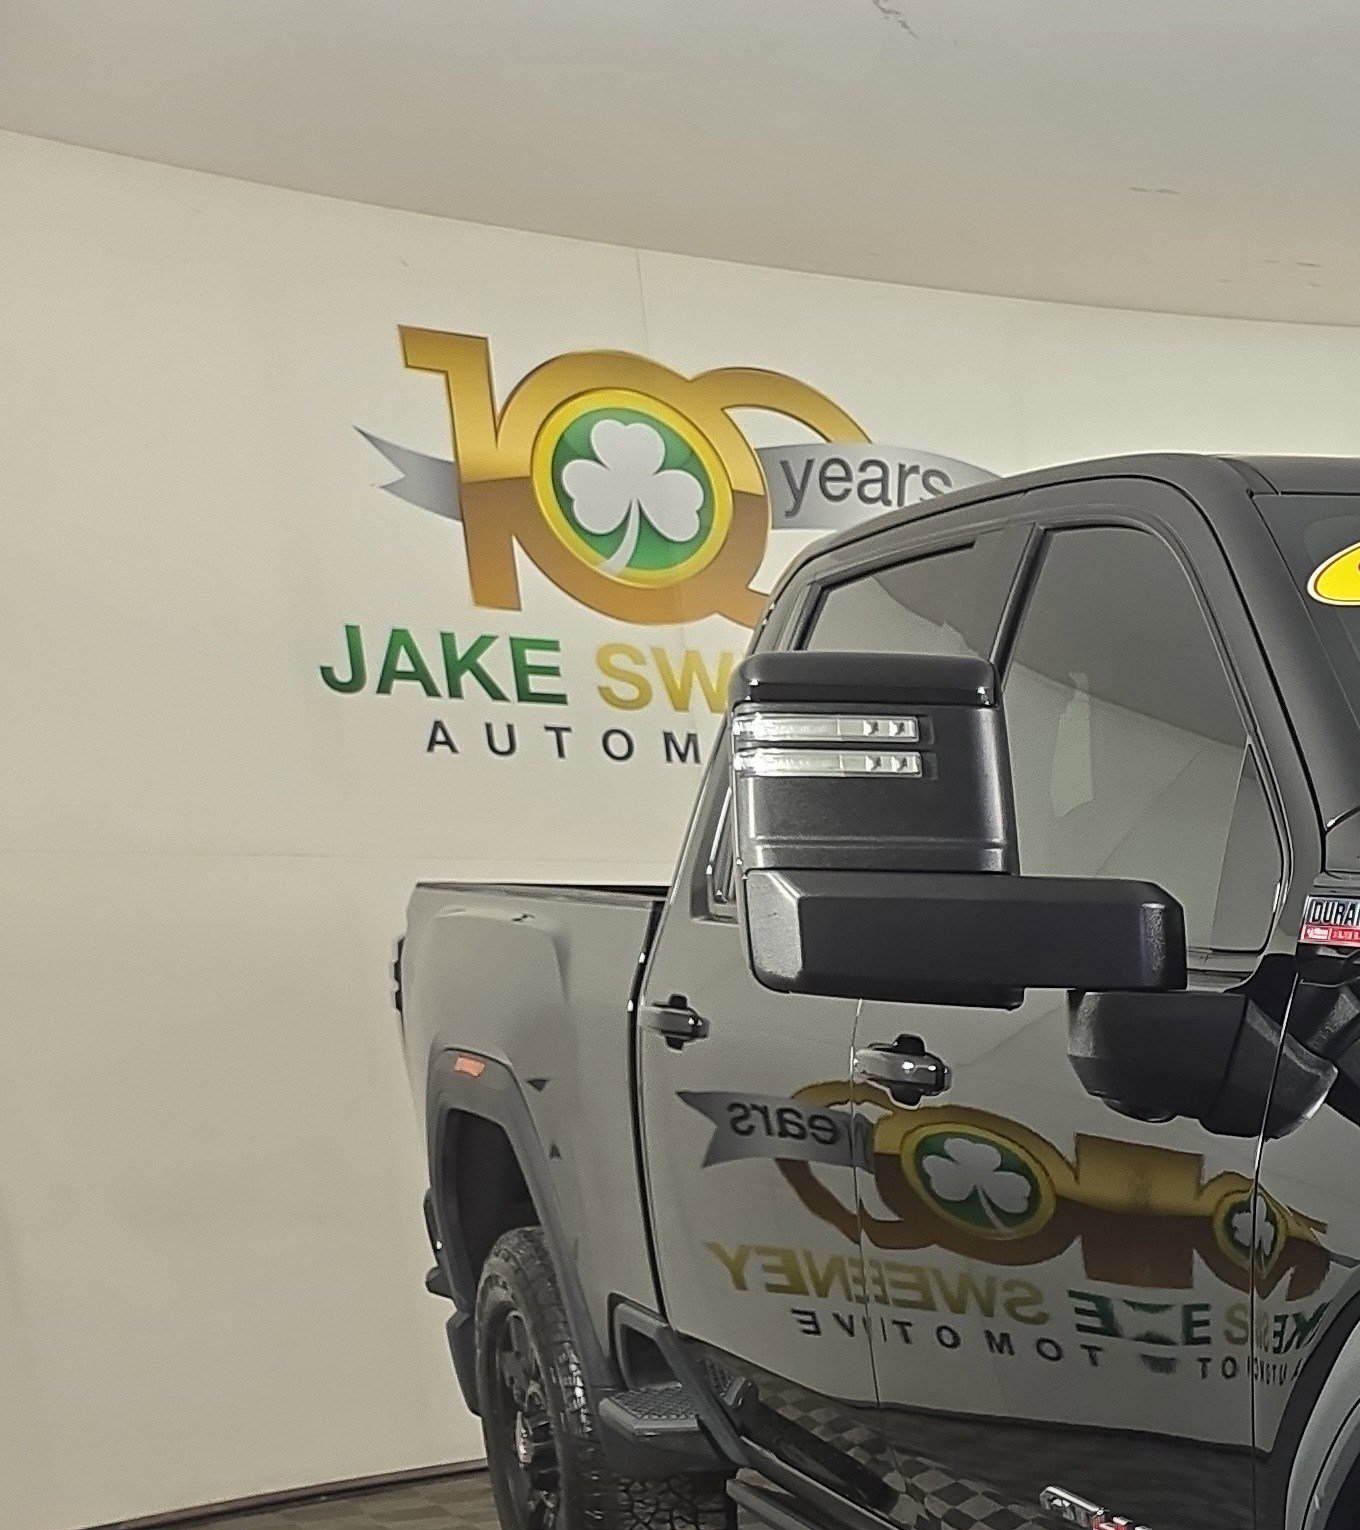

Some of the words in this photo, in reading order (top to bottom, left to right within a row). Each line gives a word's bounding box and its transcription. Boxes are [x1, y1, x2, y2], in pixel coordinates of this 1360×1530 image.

[397, 324, 874, 626] 100
[779, 456, 953, 518] years
[319, 624, 568, 706] JAKE
[426, 720, 701, 765] AUTOM
